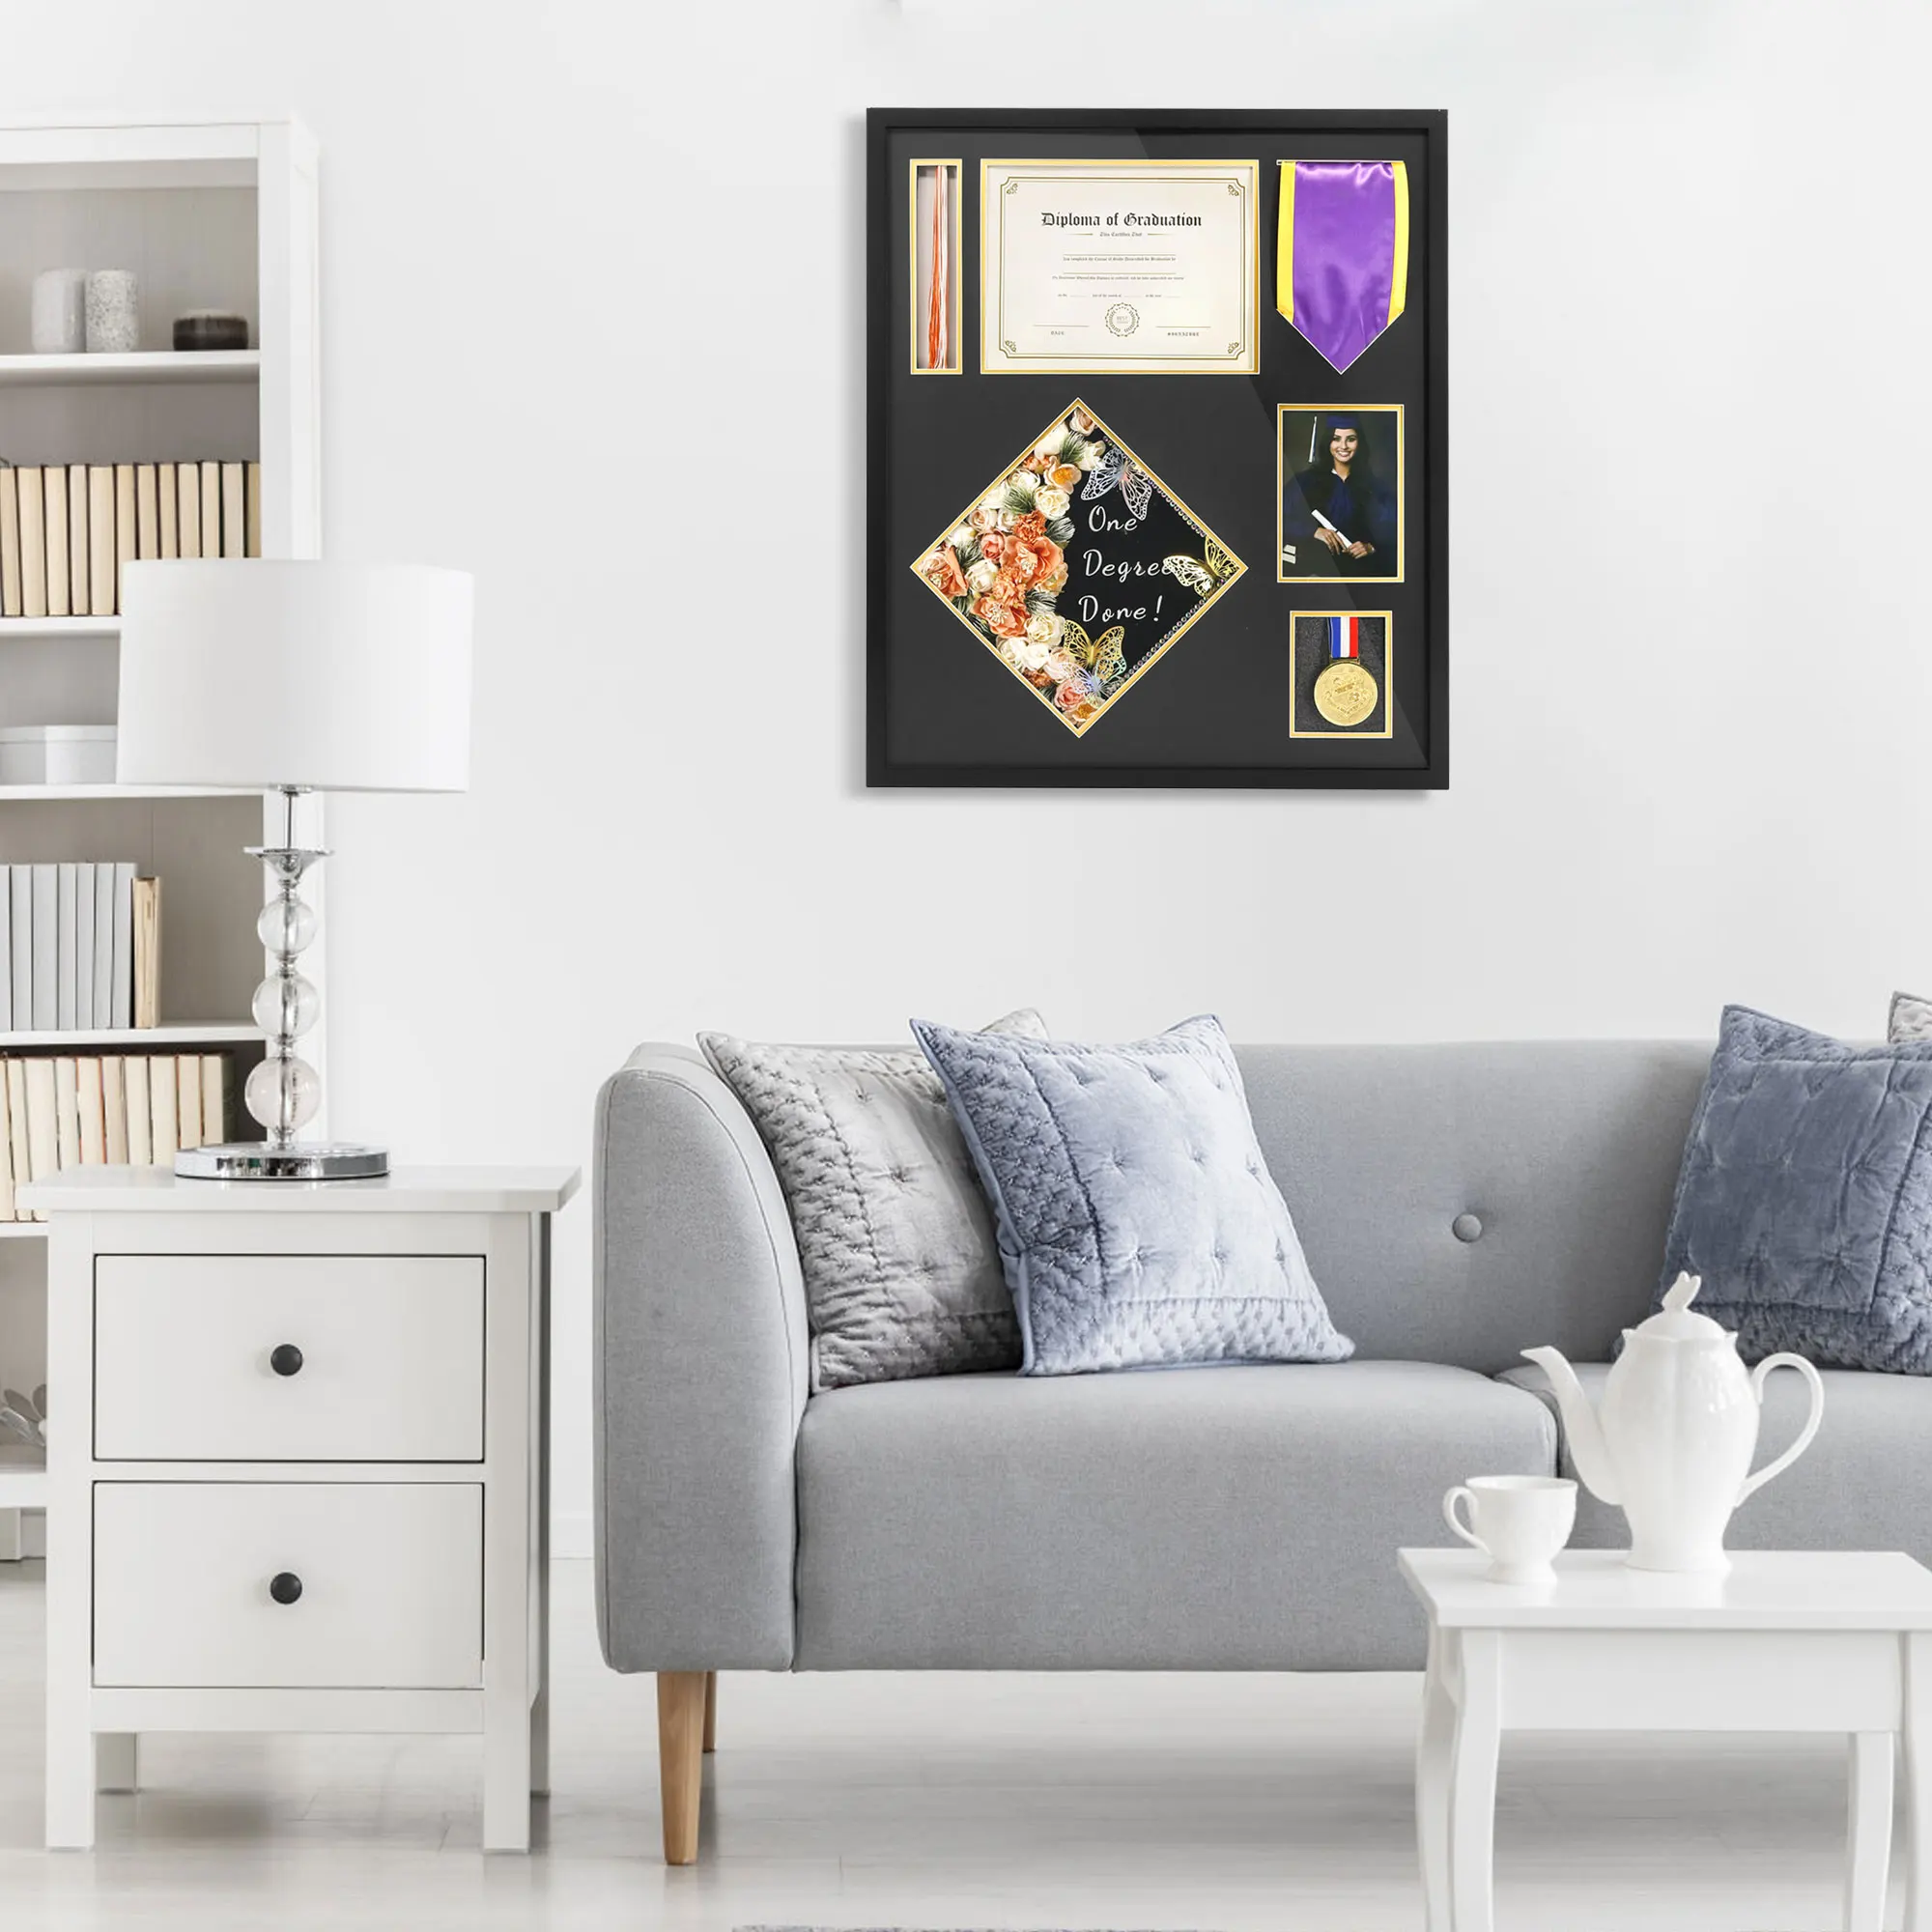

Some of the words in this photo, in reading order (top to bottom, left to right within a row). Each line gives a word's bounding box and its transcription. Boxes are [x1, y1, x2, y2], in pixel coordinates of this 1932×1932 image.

[1041, 212, 1100, 228] Diploma
[1106, 213, 1120, 226] of
[1123, 212, 1202, 227] Graduation
[1089, 504, 1137, 532] One
[1078, 595, 1162, 623] Done!
